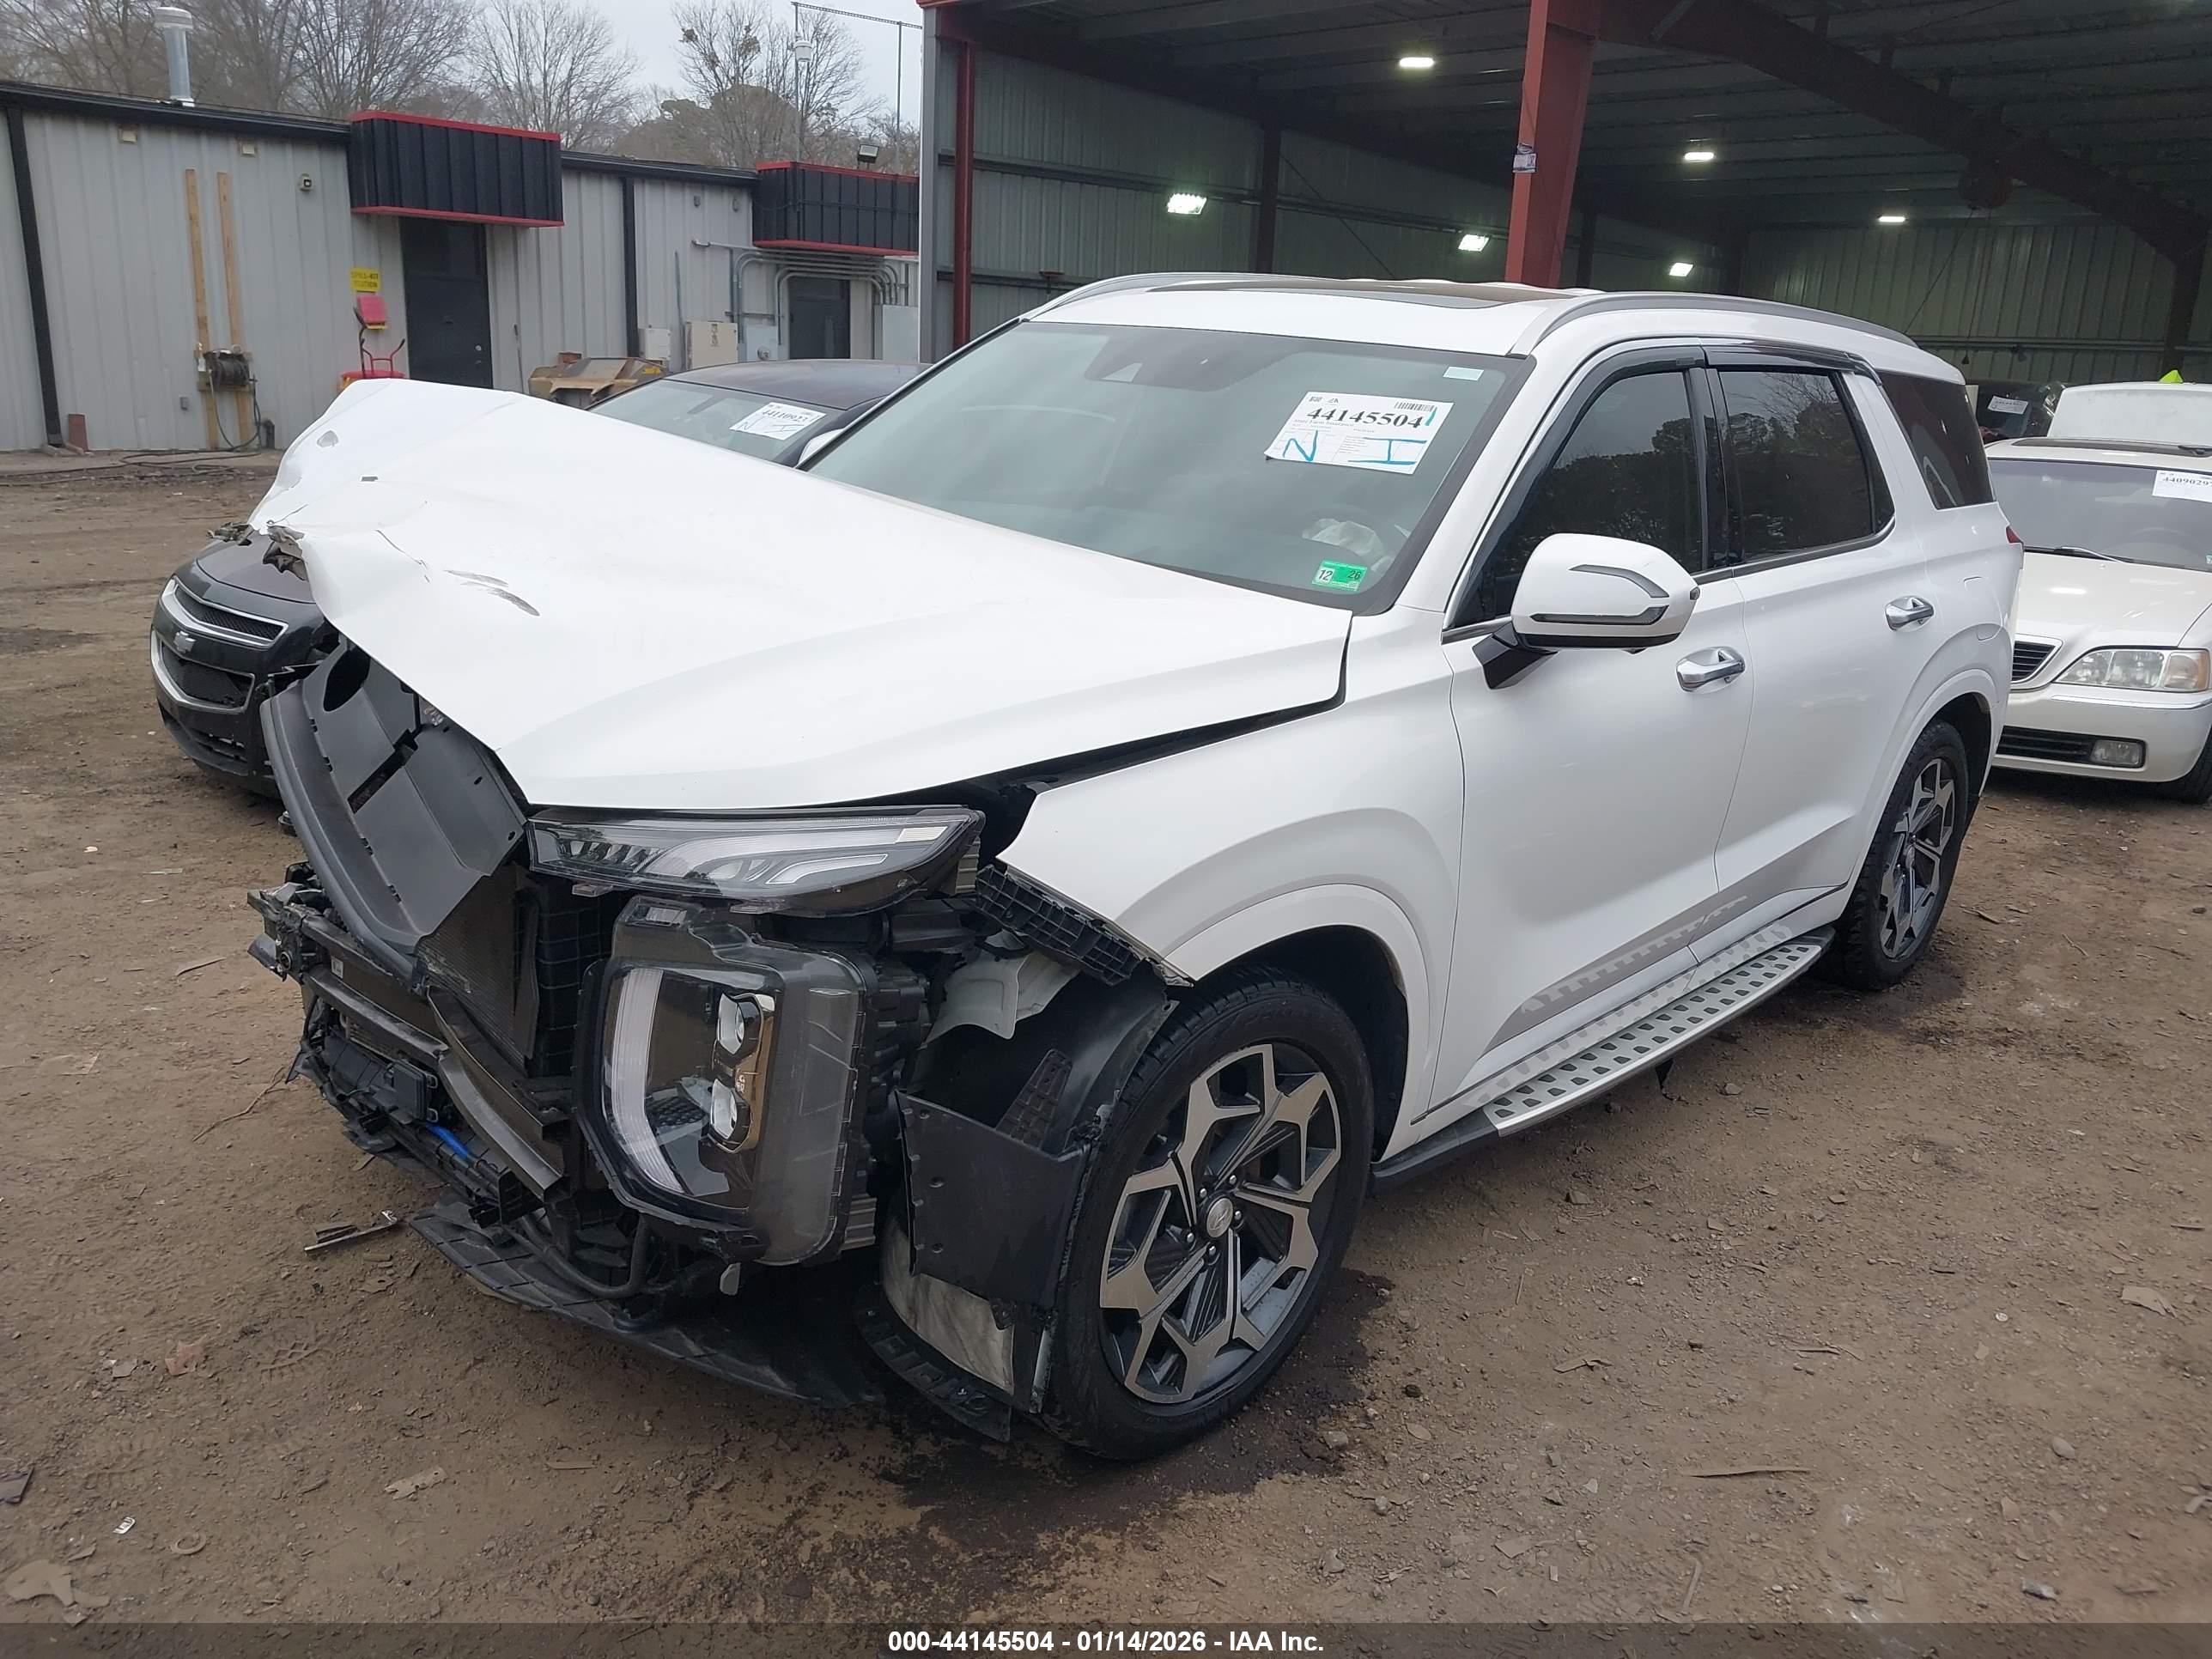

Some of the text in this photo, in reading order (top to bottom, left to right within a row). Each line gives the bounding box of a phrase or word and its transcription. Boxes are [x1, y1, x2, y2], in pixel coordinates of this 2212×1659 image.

[1307, 408, 1424, 428] 44145504
[1318, 569, 1362, 581] 12 26
